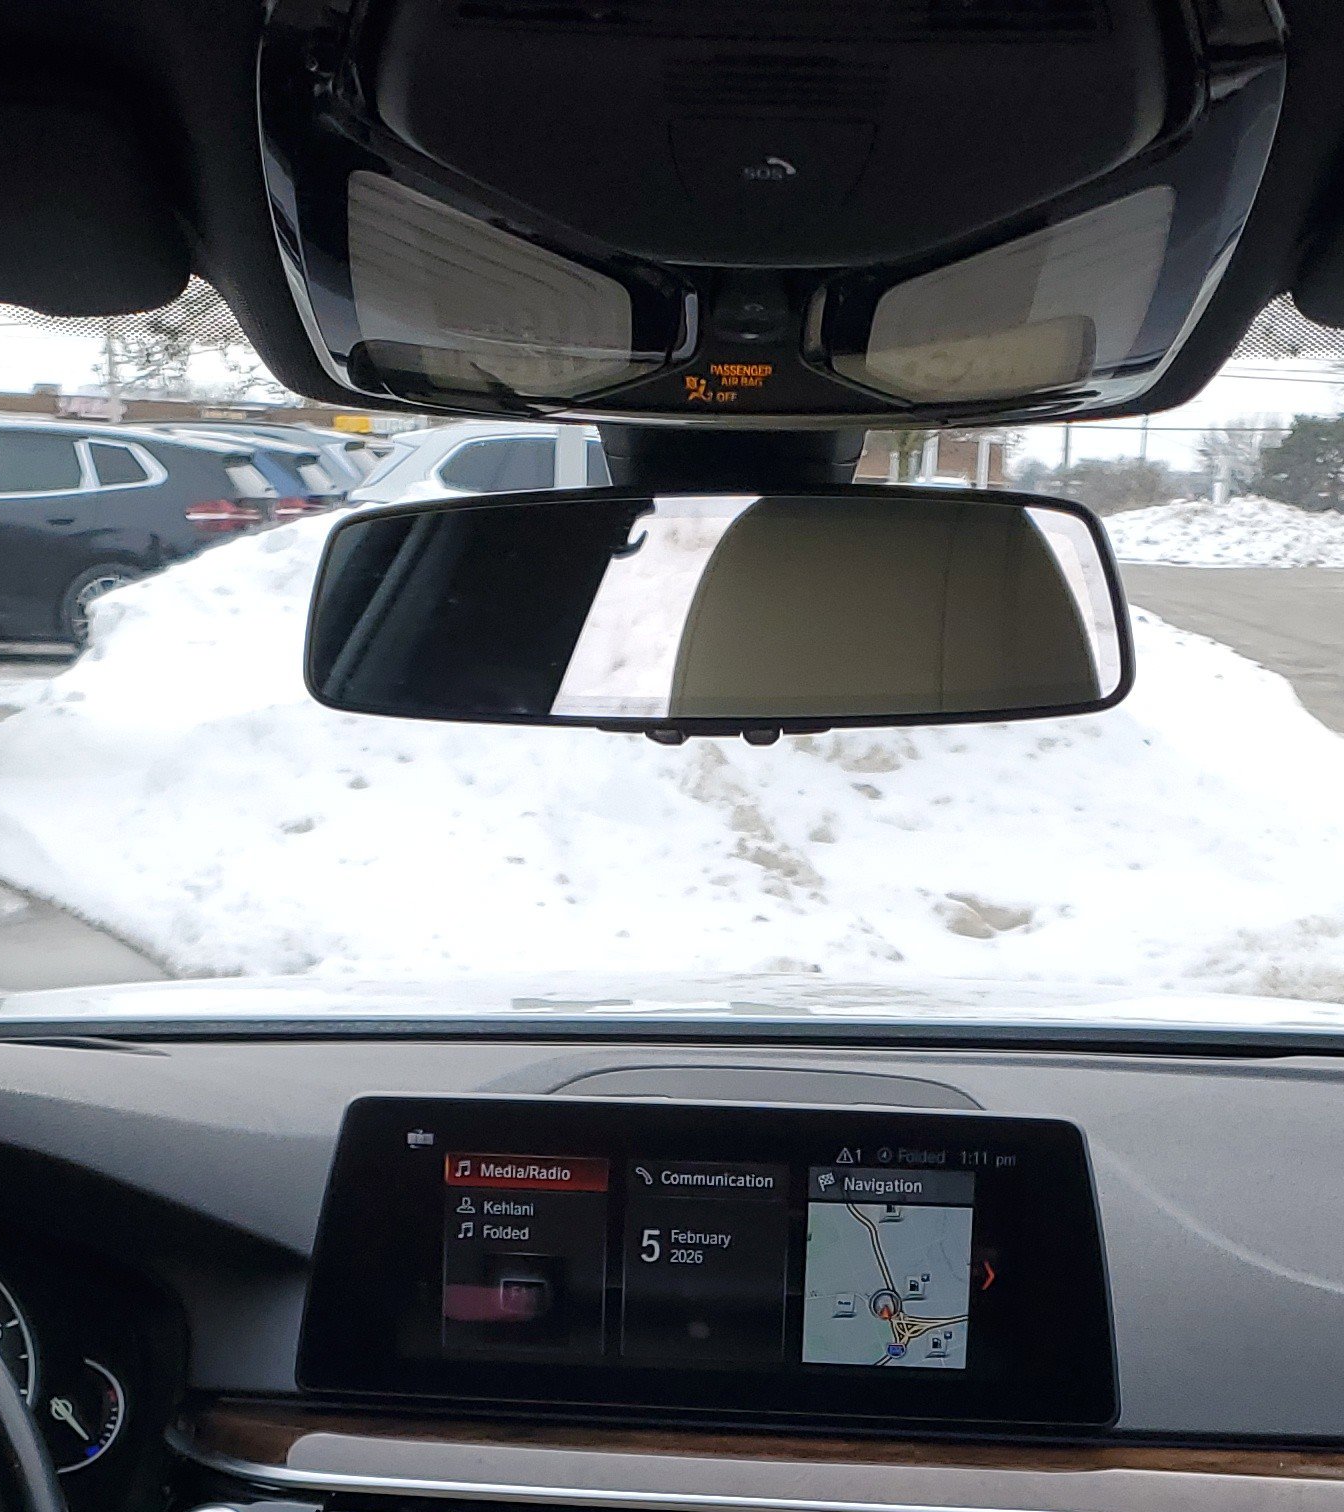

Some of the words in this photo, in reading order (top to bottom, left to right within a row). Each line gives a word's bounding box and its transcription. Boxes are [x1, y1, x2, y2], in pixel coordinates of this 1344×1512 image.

[710, 364, 773, 376] PASSENGER
[961, 1150, 988, 1166] 1:11
[480, 1163, 571, 1181] Media/Radio
[661, 1170, 773, 1188] Communication
[844, 1177, 923, 1194] Navigation
[483, 1200, 534, 1217] Kehlani
[483, 1225, 529, 1241] Folded
[640, 1229, 661, 1263] 5
[671, 1229, 732, 1249] February
[670, 1249, 703, 1264] 2026
